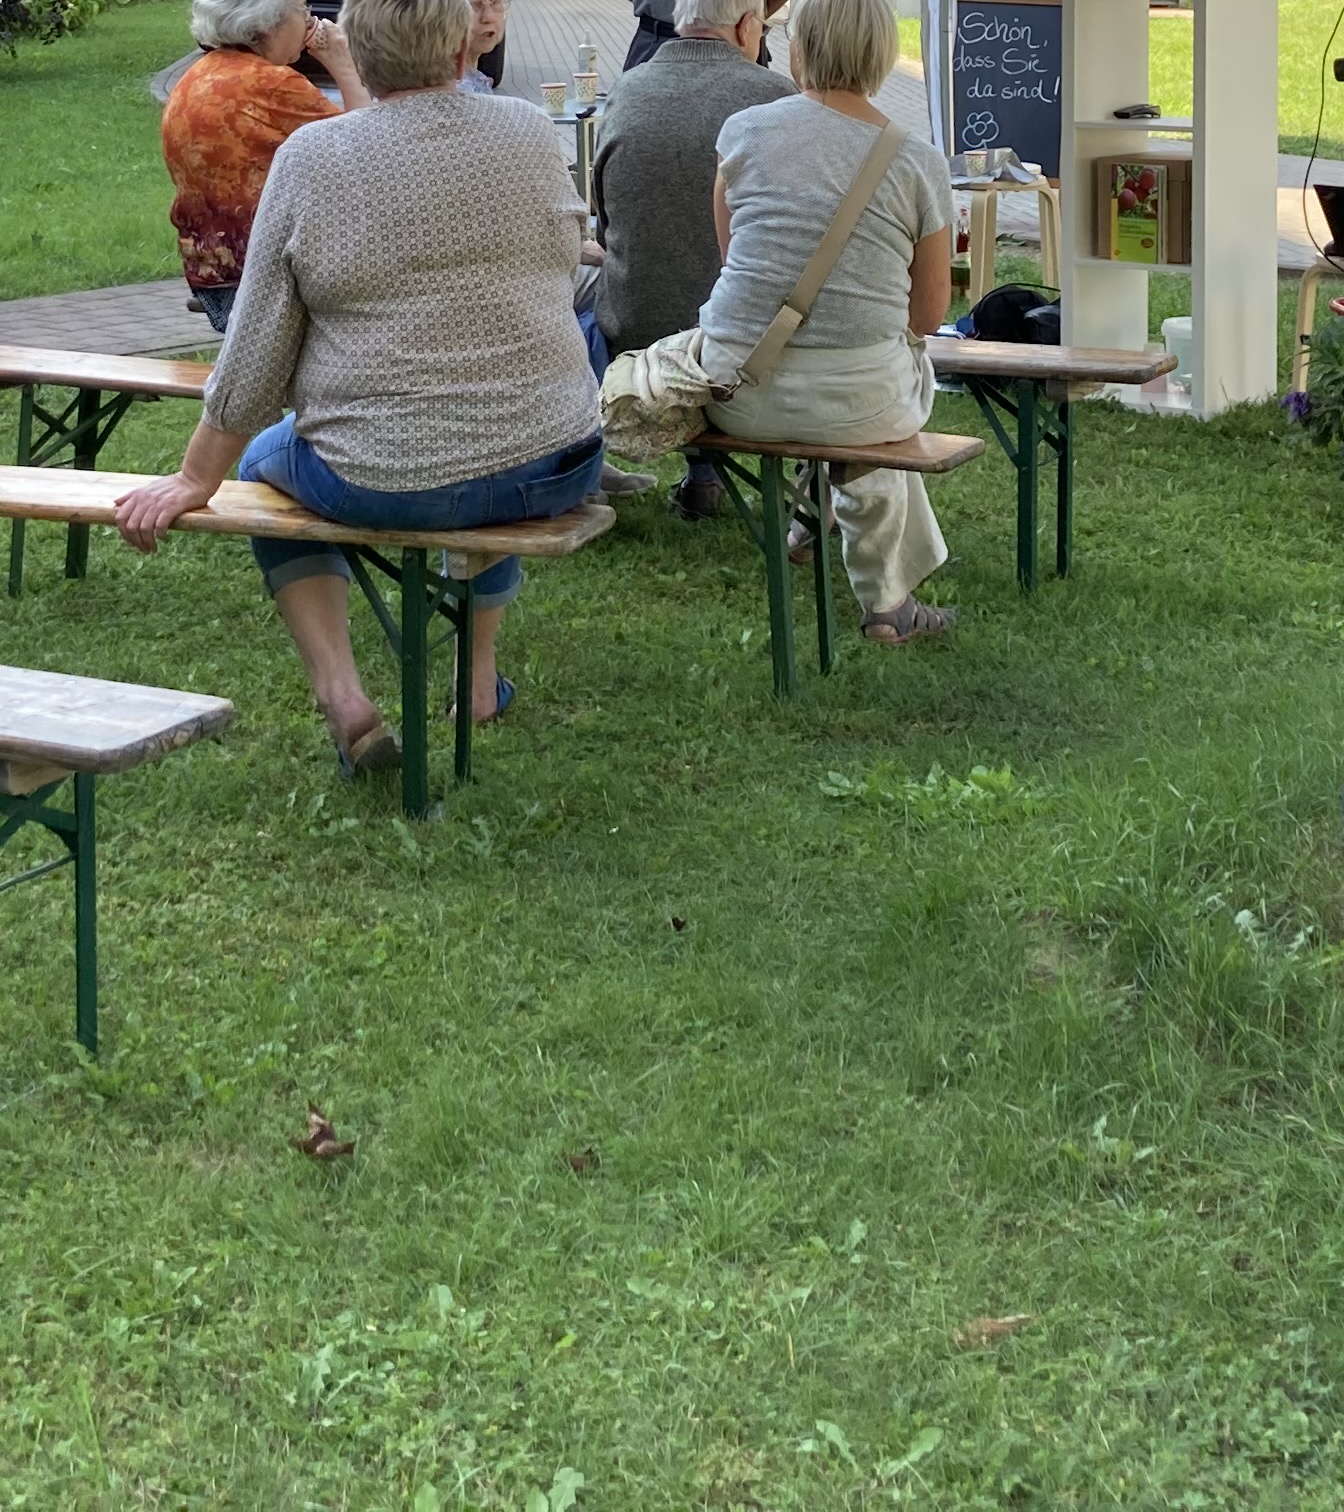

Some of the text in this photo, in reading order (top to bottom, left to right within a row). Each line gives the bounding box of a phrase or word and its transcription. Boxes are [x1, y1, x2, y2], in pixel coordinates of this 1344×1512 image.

[953, 44, 1049, 75] dass Sie
[966, 76, 1061, 104] da sind!
